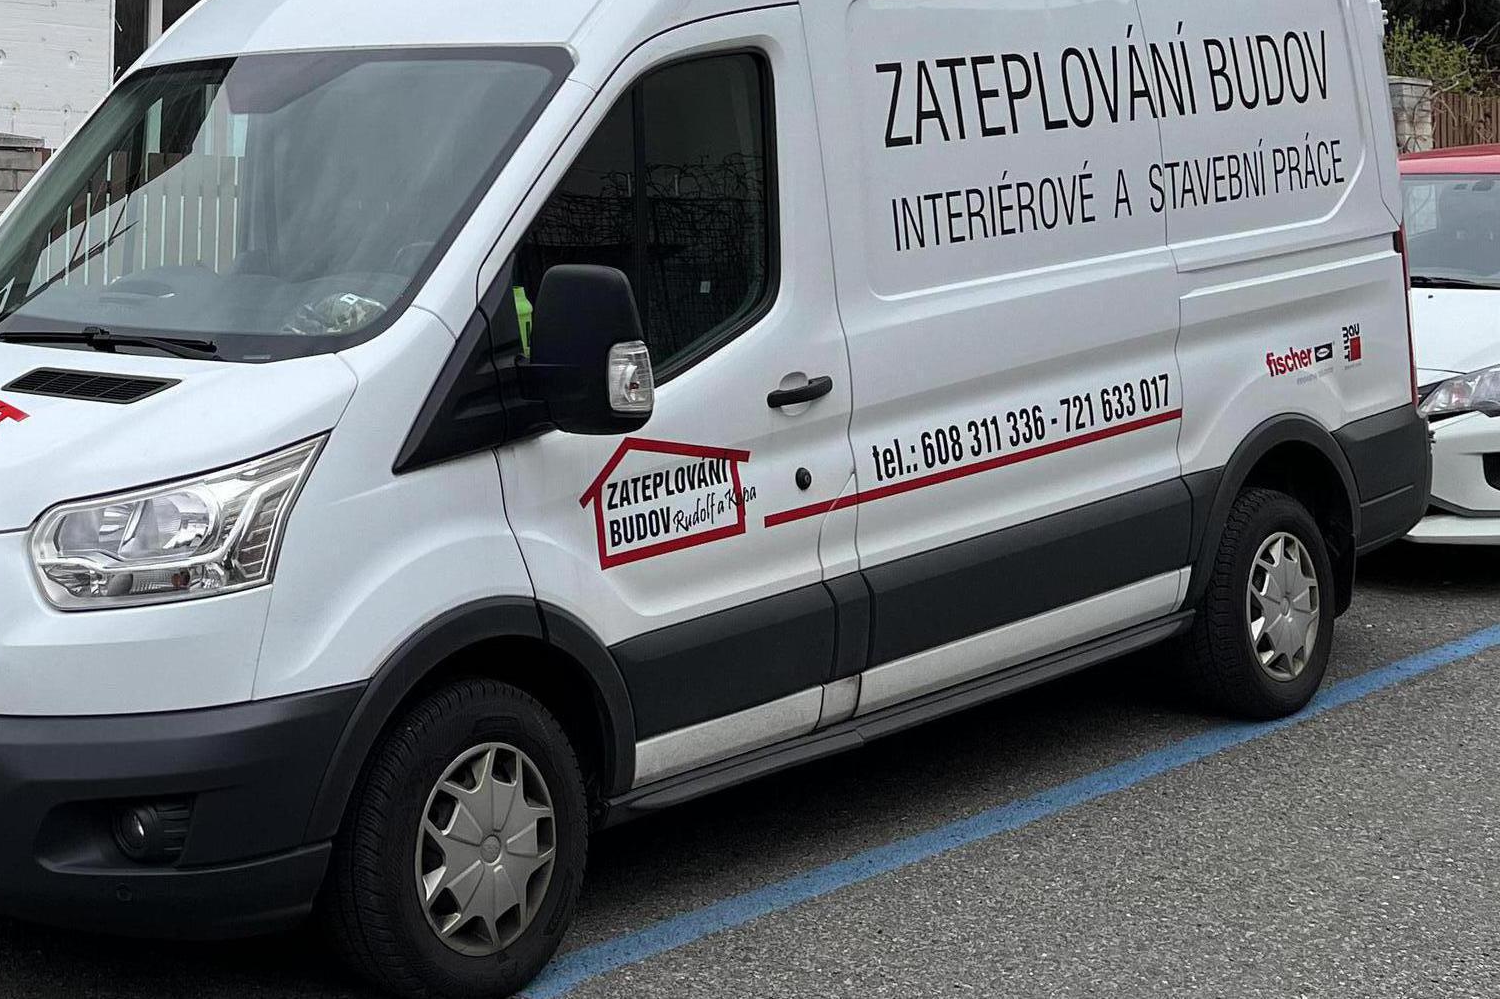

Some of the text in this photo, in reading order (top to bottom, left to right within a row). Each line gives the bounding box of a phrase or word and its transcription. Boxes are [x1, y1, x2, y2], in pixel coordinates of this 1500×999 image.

[875, 21, 1328, 148] ZATEPLOVÁNÍ BUDOV
[891, 132, 1345, 252] INTERIÉROVÉ A STAVEBNÍ PRÁCE
[1265, 347, 1313, 378] fischer
[872, 438, 919, 482] tel.:
[920, 424, 964, 469] 608
[967, 415, 1002, 458] 311
[1006, 404, 1046, 448] 336
[1059, 392, 1095, 433] 721
[1100, 382, 1137, 423] 633
[1139, 373, 1169, 413] 017
[608, 505, 671, 548] BUDOV
[672, 492, 716, 533] Rudolf
[717, 500, 725, 514] a
